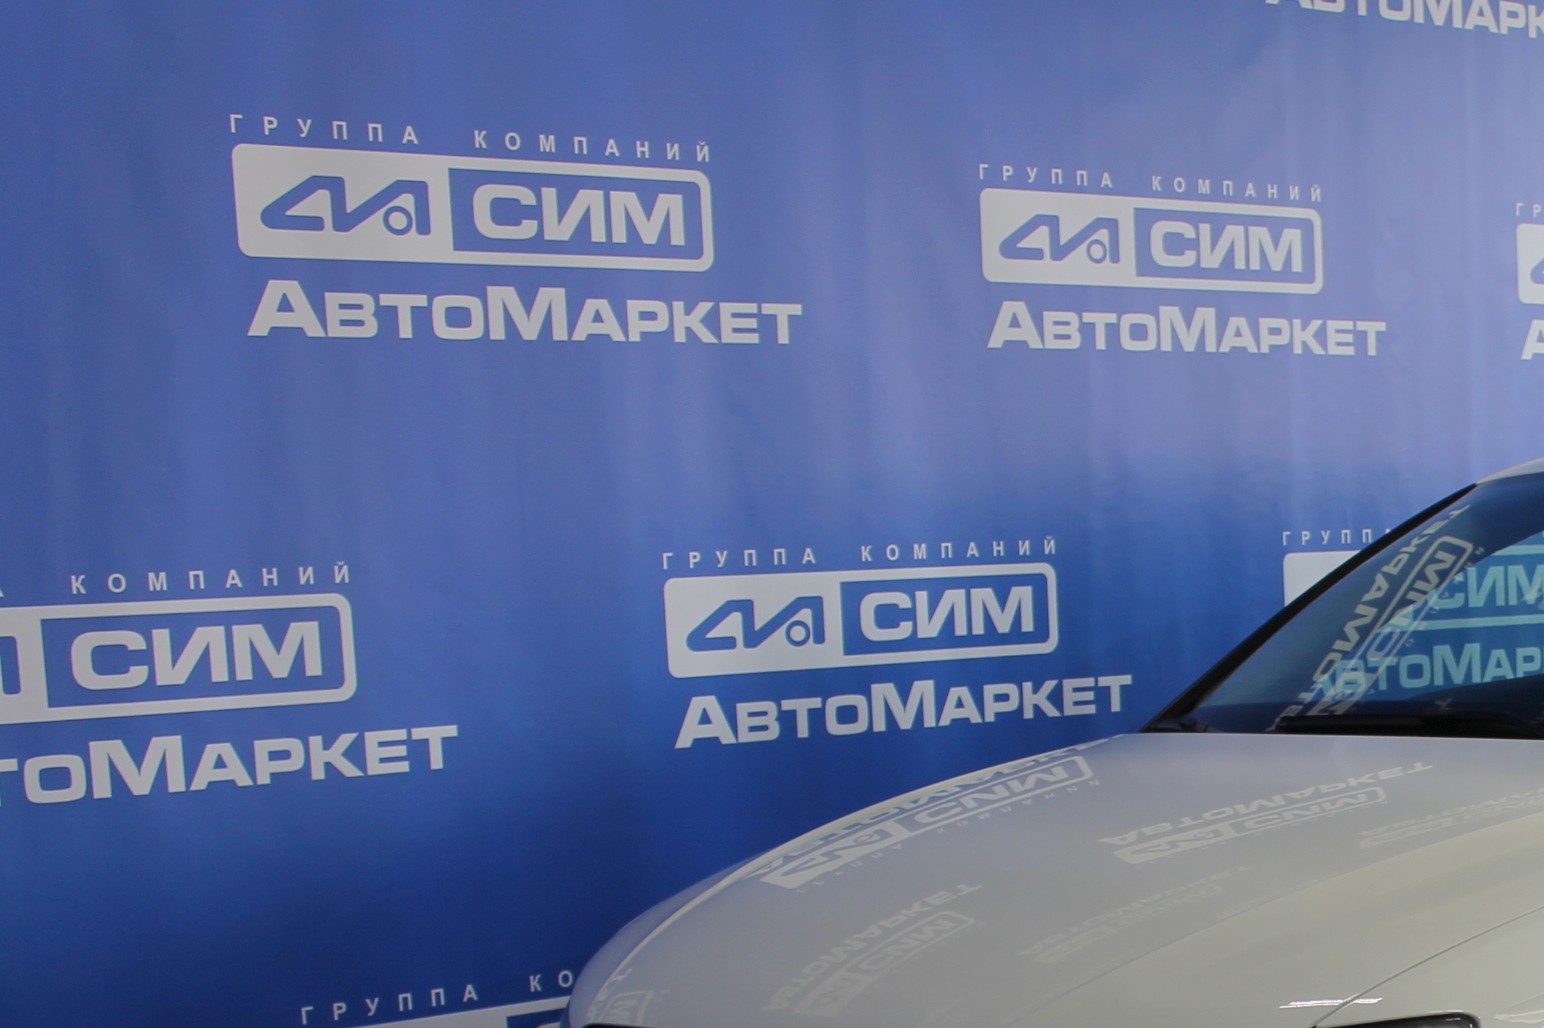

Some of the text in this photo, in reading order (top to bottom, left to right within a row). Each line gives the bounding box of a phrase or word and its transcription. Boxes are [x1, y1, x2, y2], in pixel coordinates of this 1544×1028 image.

[229, 114, 711, 162] ГРУППА КОМПАНИЙ
[978, 164, 1322, 202] ГРУППА КОМПАНИЙ
[472, 183, 685, 246] СИМ
[1149, 220, 1304, 272] СИМ
[661, 536, 1056, 570] ГРУППА КОМПАНИЙ
[1282, 528, 1391, 547] ГРУПП
[70, 561, 350, 594] КОМПАНИЙ
[859, 586, 1034, 642] СИМ
[70, 620, 323, 691] СИМ
[300, 985, 478, 1025] ГРУППА
